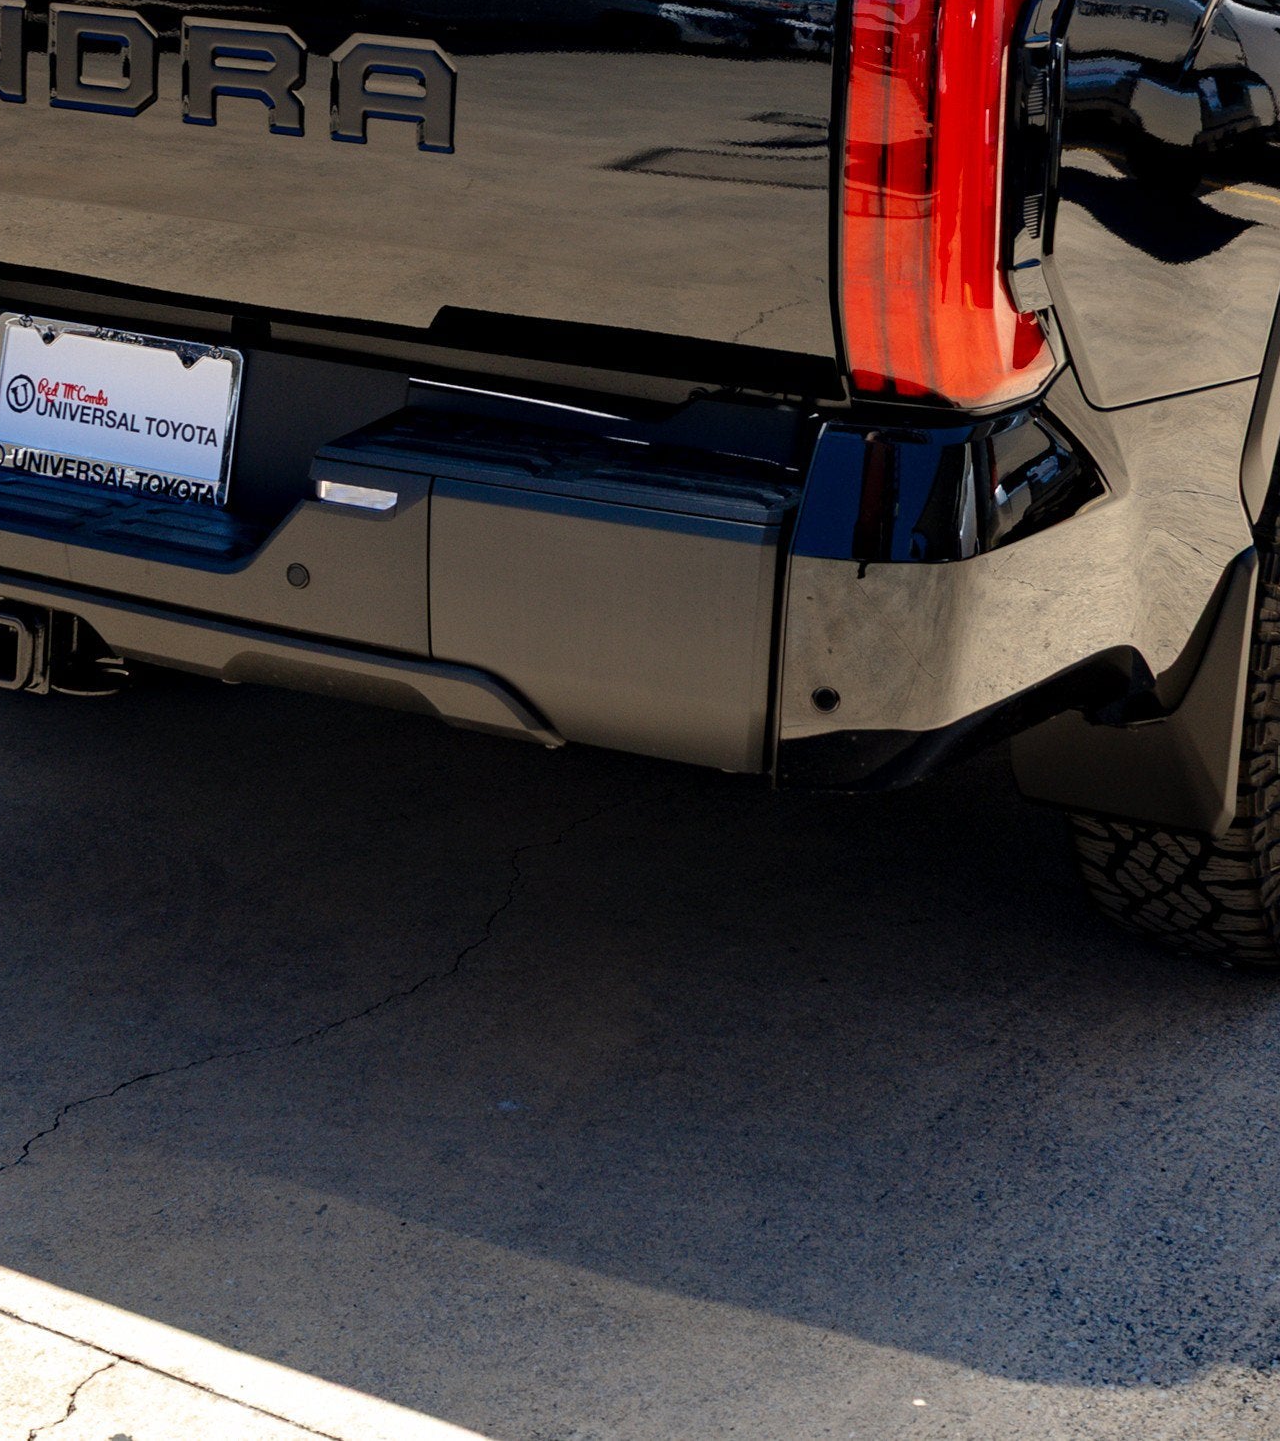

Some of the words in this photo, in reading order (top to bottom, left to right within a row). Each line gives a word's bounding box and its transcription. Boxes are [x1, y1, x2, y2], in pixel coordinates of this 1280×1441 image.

[37, 377, 60, 404] Red
[35, 396, 141, 434] UNIVERSAL
[145, 415, 219, 448] TOYOTA
[11, 448, 133, 492] UNIVERSAL
[135, 469, 218, 507] TOYOTA
